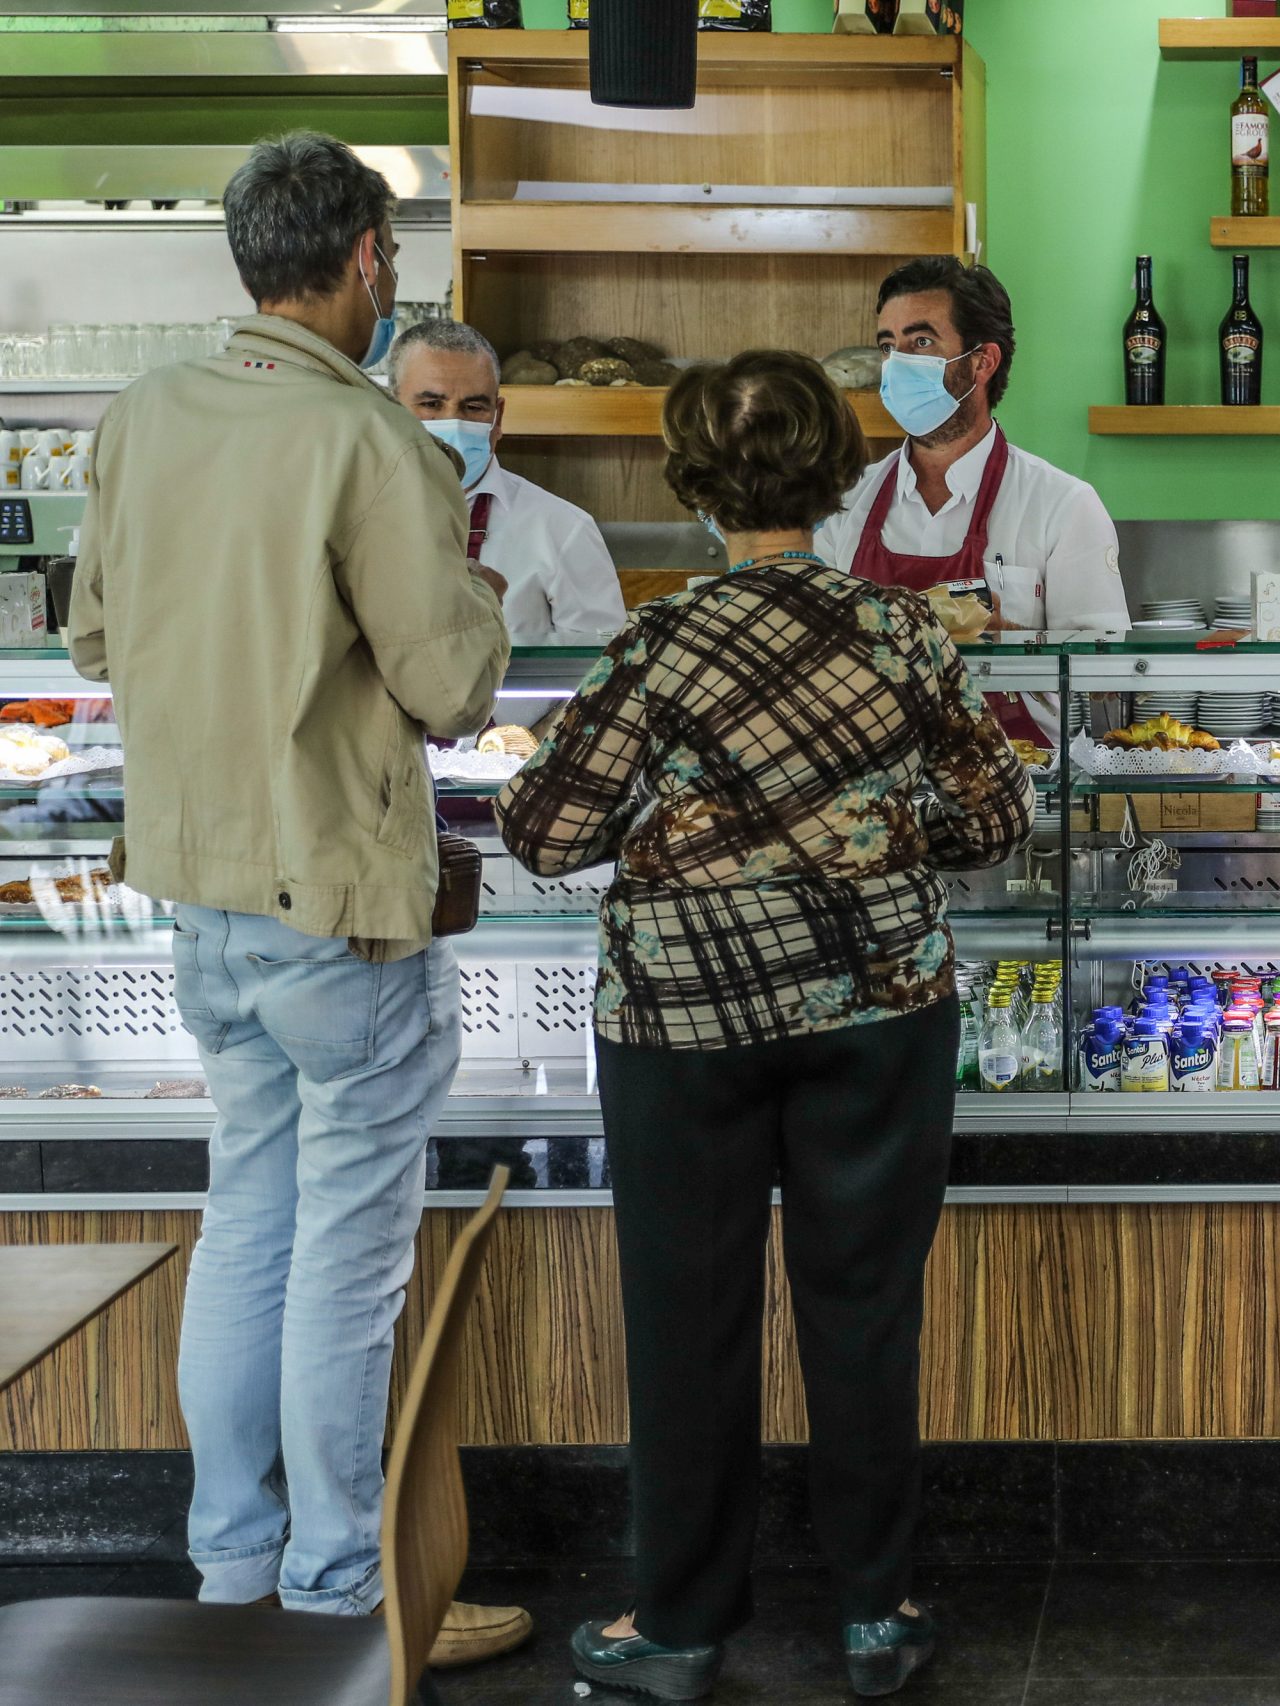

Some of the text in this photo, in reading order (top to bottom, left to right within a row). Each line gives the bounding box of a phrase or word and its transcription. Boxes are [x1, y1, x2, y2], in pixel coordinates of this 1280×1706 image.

[1163, 804, 1198, 817] Nicola
[1127, 1045, 1146, 1055] Santal
[1141, 1053, 1164, 1070] Plus
[1174, 1048, 1209, 1070] Santal
